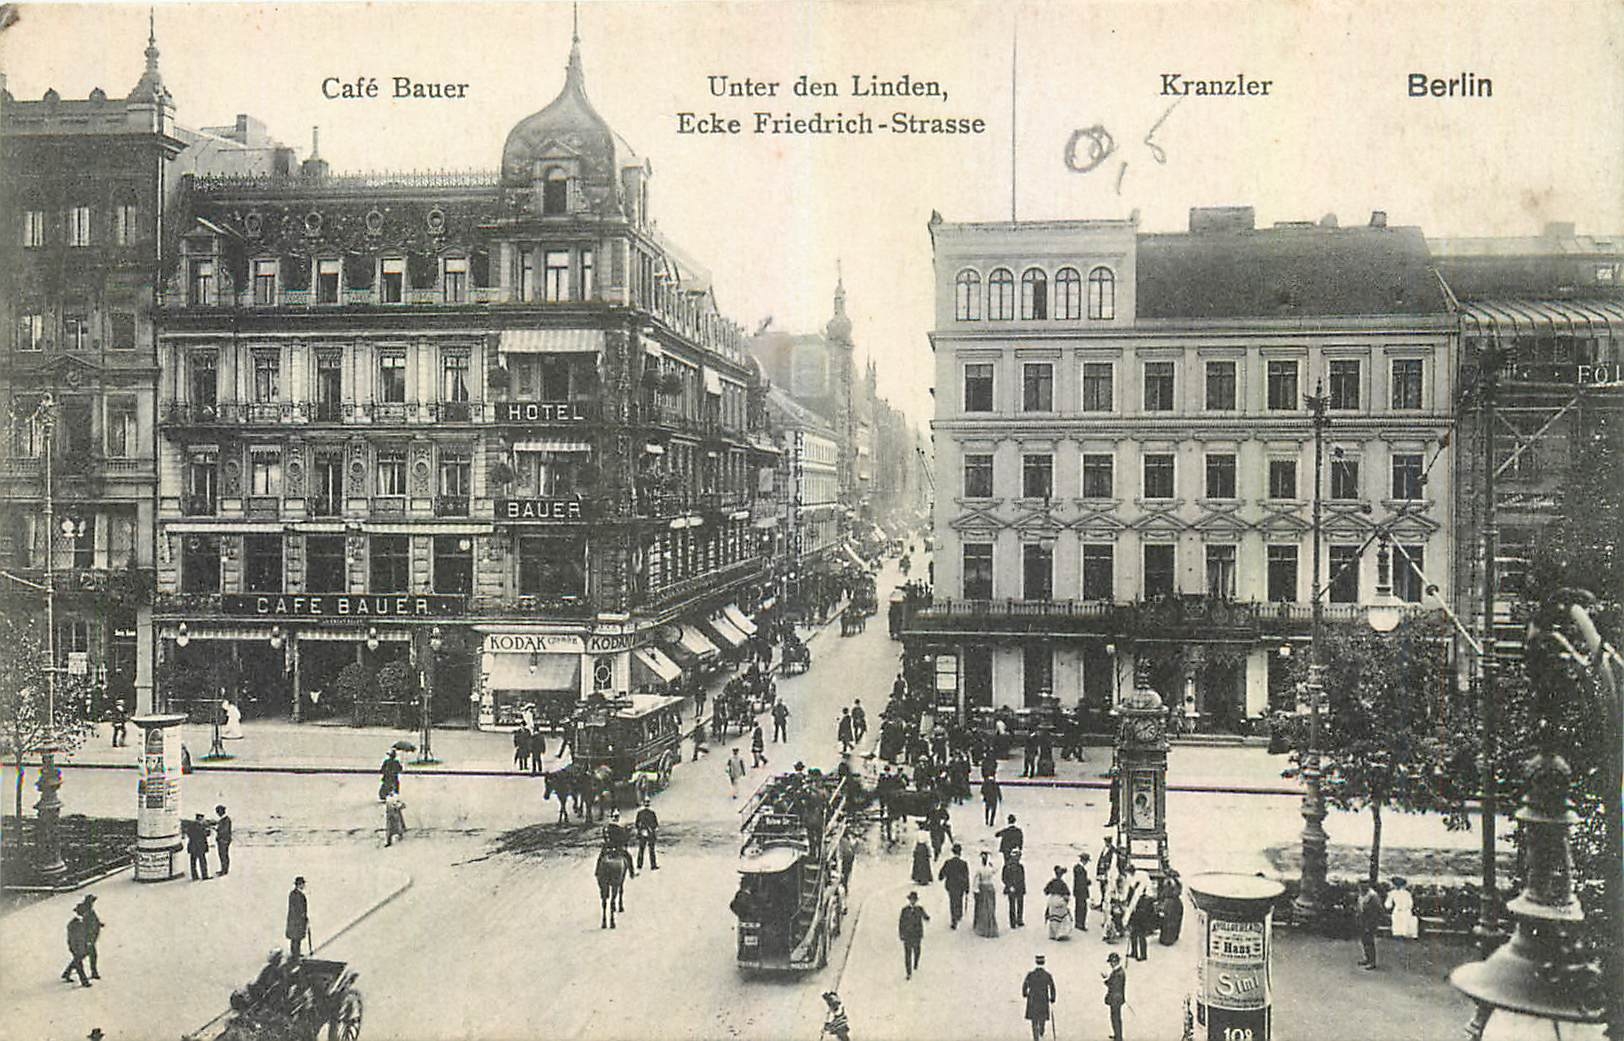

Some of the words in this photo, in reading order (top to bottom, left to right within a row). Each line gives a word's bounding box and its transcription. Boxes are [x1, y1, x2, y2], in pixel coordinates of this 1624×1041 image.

[509, 404, 584, 420] HOTEL
[508, 502, 581, 518] BAUER
[256, 597, 323, 614] CAFE
[337, 597, 430, 615] BAUER
[490, 636, 547, 650] KODAK
